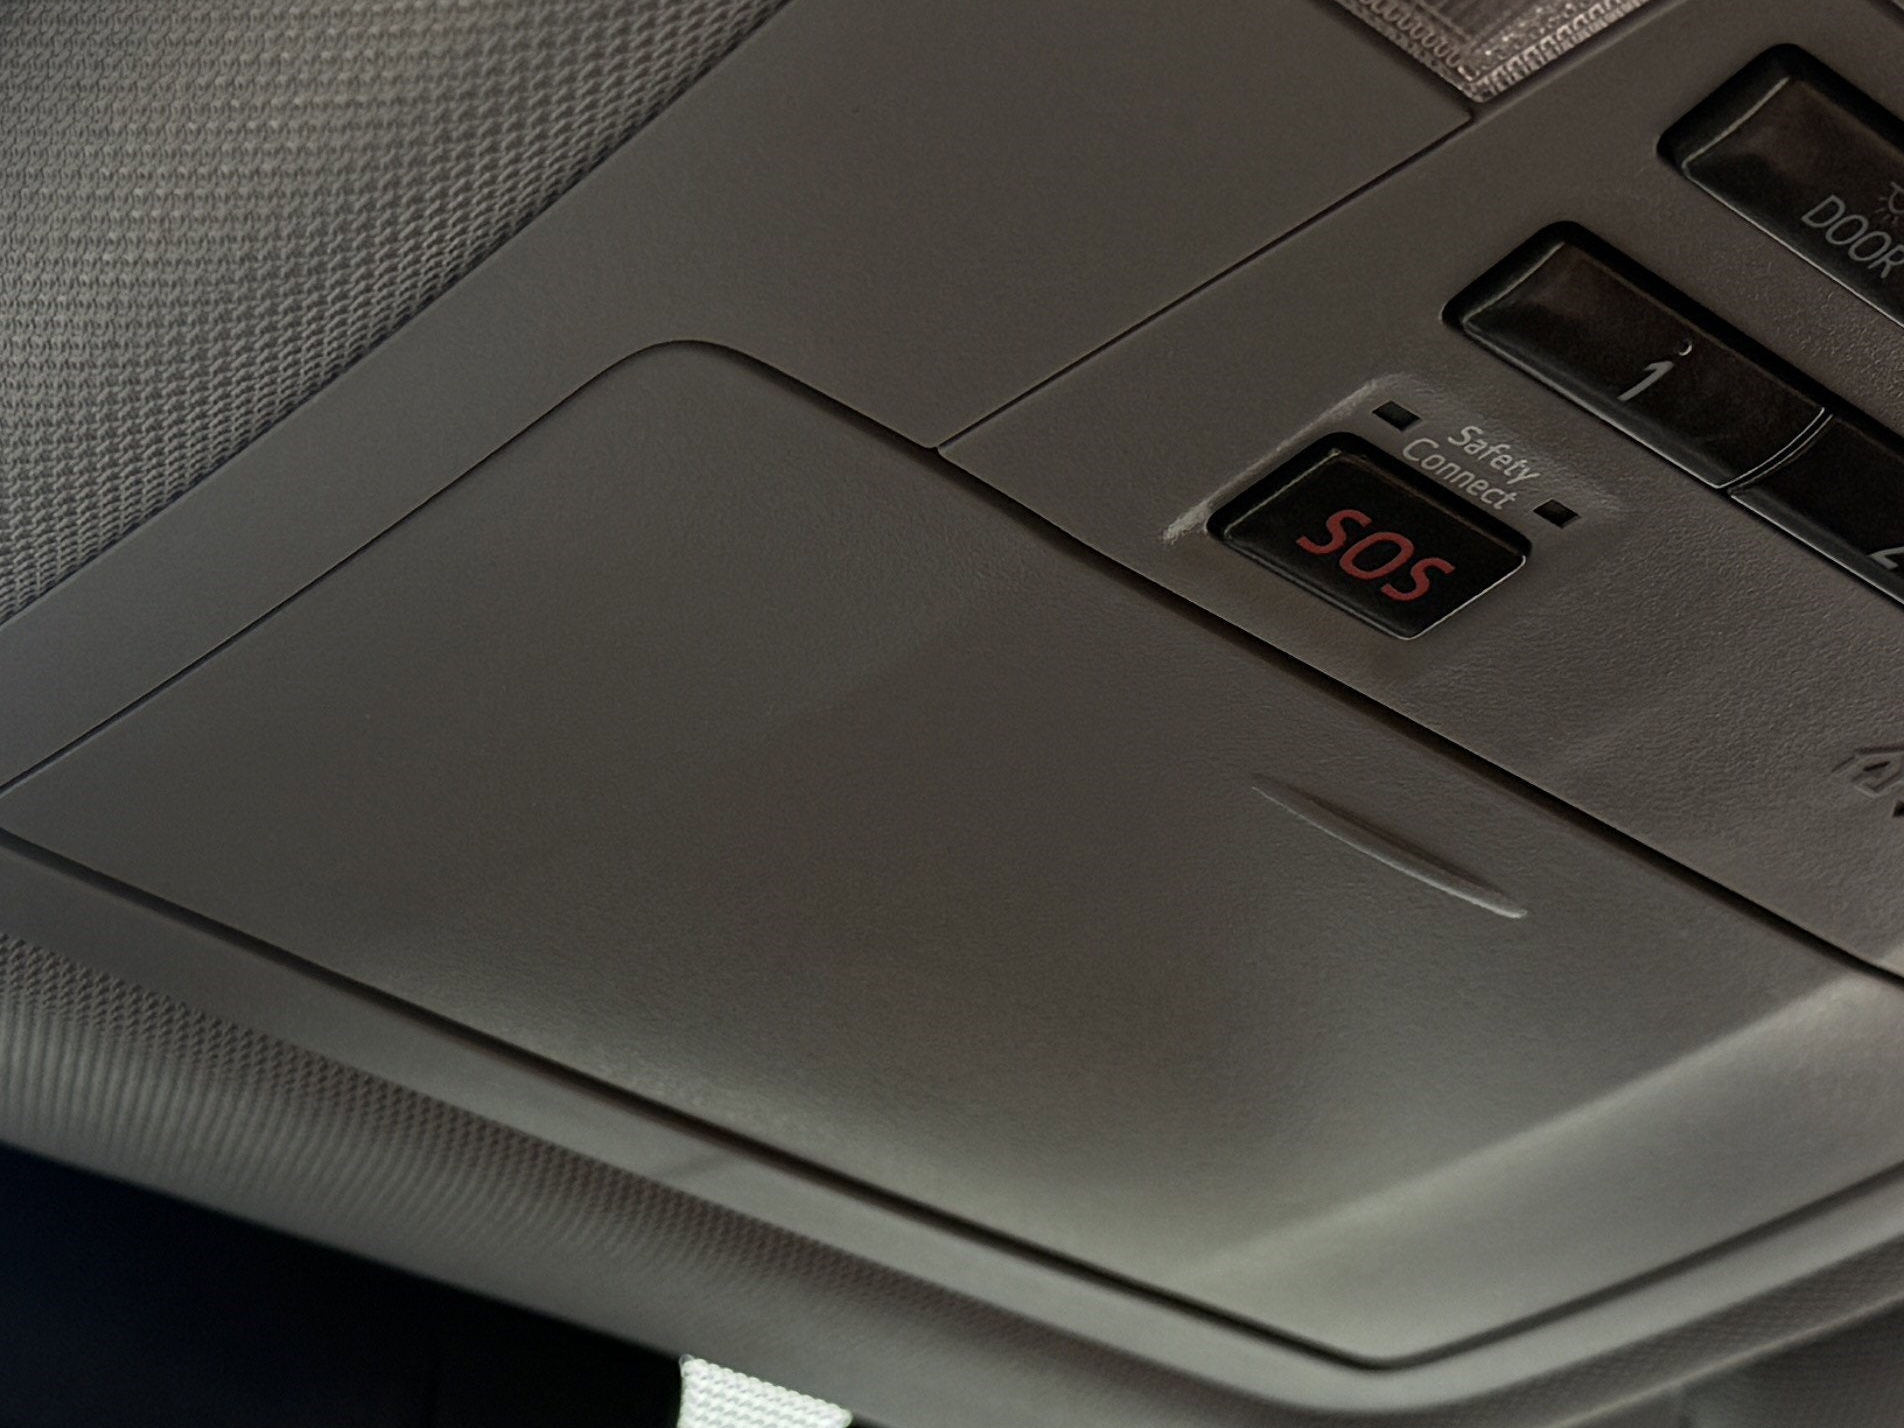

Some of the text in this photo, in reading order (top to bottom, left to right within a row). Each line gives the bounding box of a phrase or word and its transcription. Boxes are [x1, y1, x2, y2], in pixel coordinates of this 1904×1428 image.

[1616, 359, 1676, 403] 1
[1401, 437, 1518, 511] Connect
[1446, 424, 1542, 486] Safety
[1295, 508, 1457, 602] SOS
